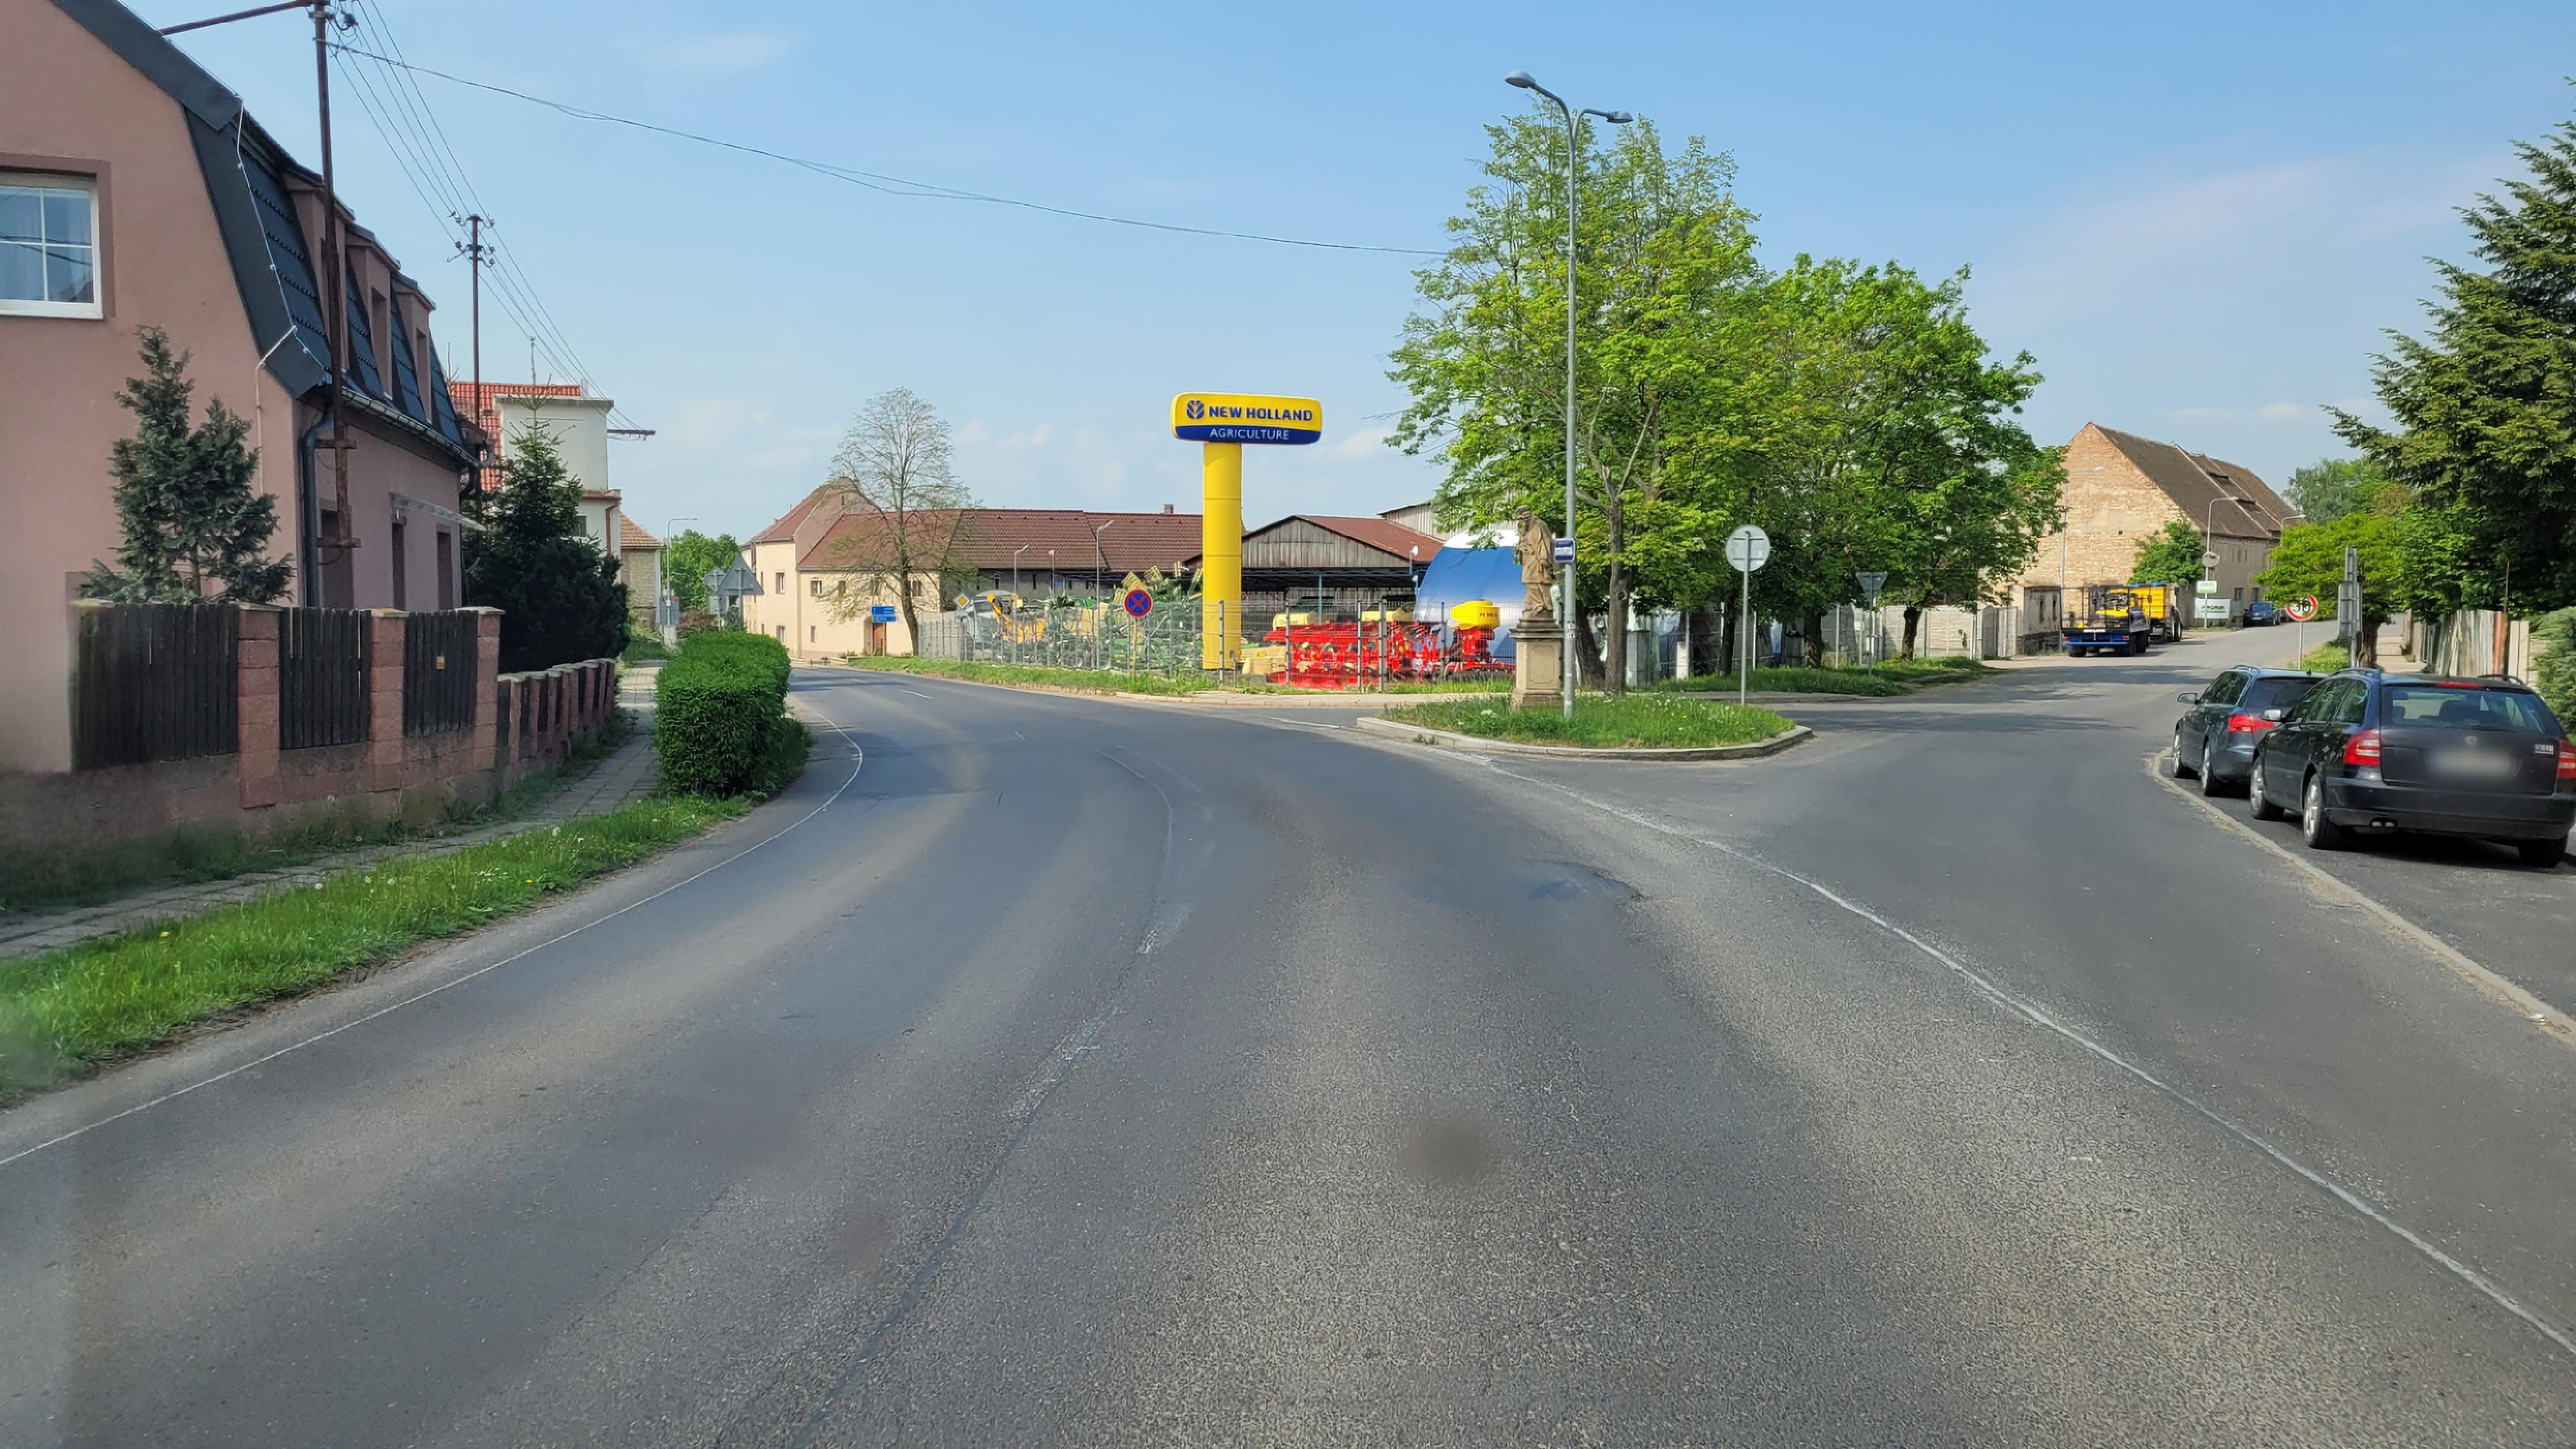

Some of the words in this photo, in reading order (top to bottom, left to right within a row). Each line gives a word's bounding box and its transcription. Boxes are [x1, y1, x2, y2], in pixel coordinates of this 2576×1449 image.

[1208, 405, 1242, 418] NEW
[1245, 407, 1313, 421] HOLLAND
[1209, 428, 1290, 440] AGRICULTURE
